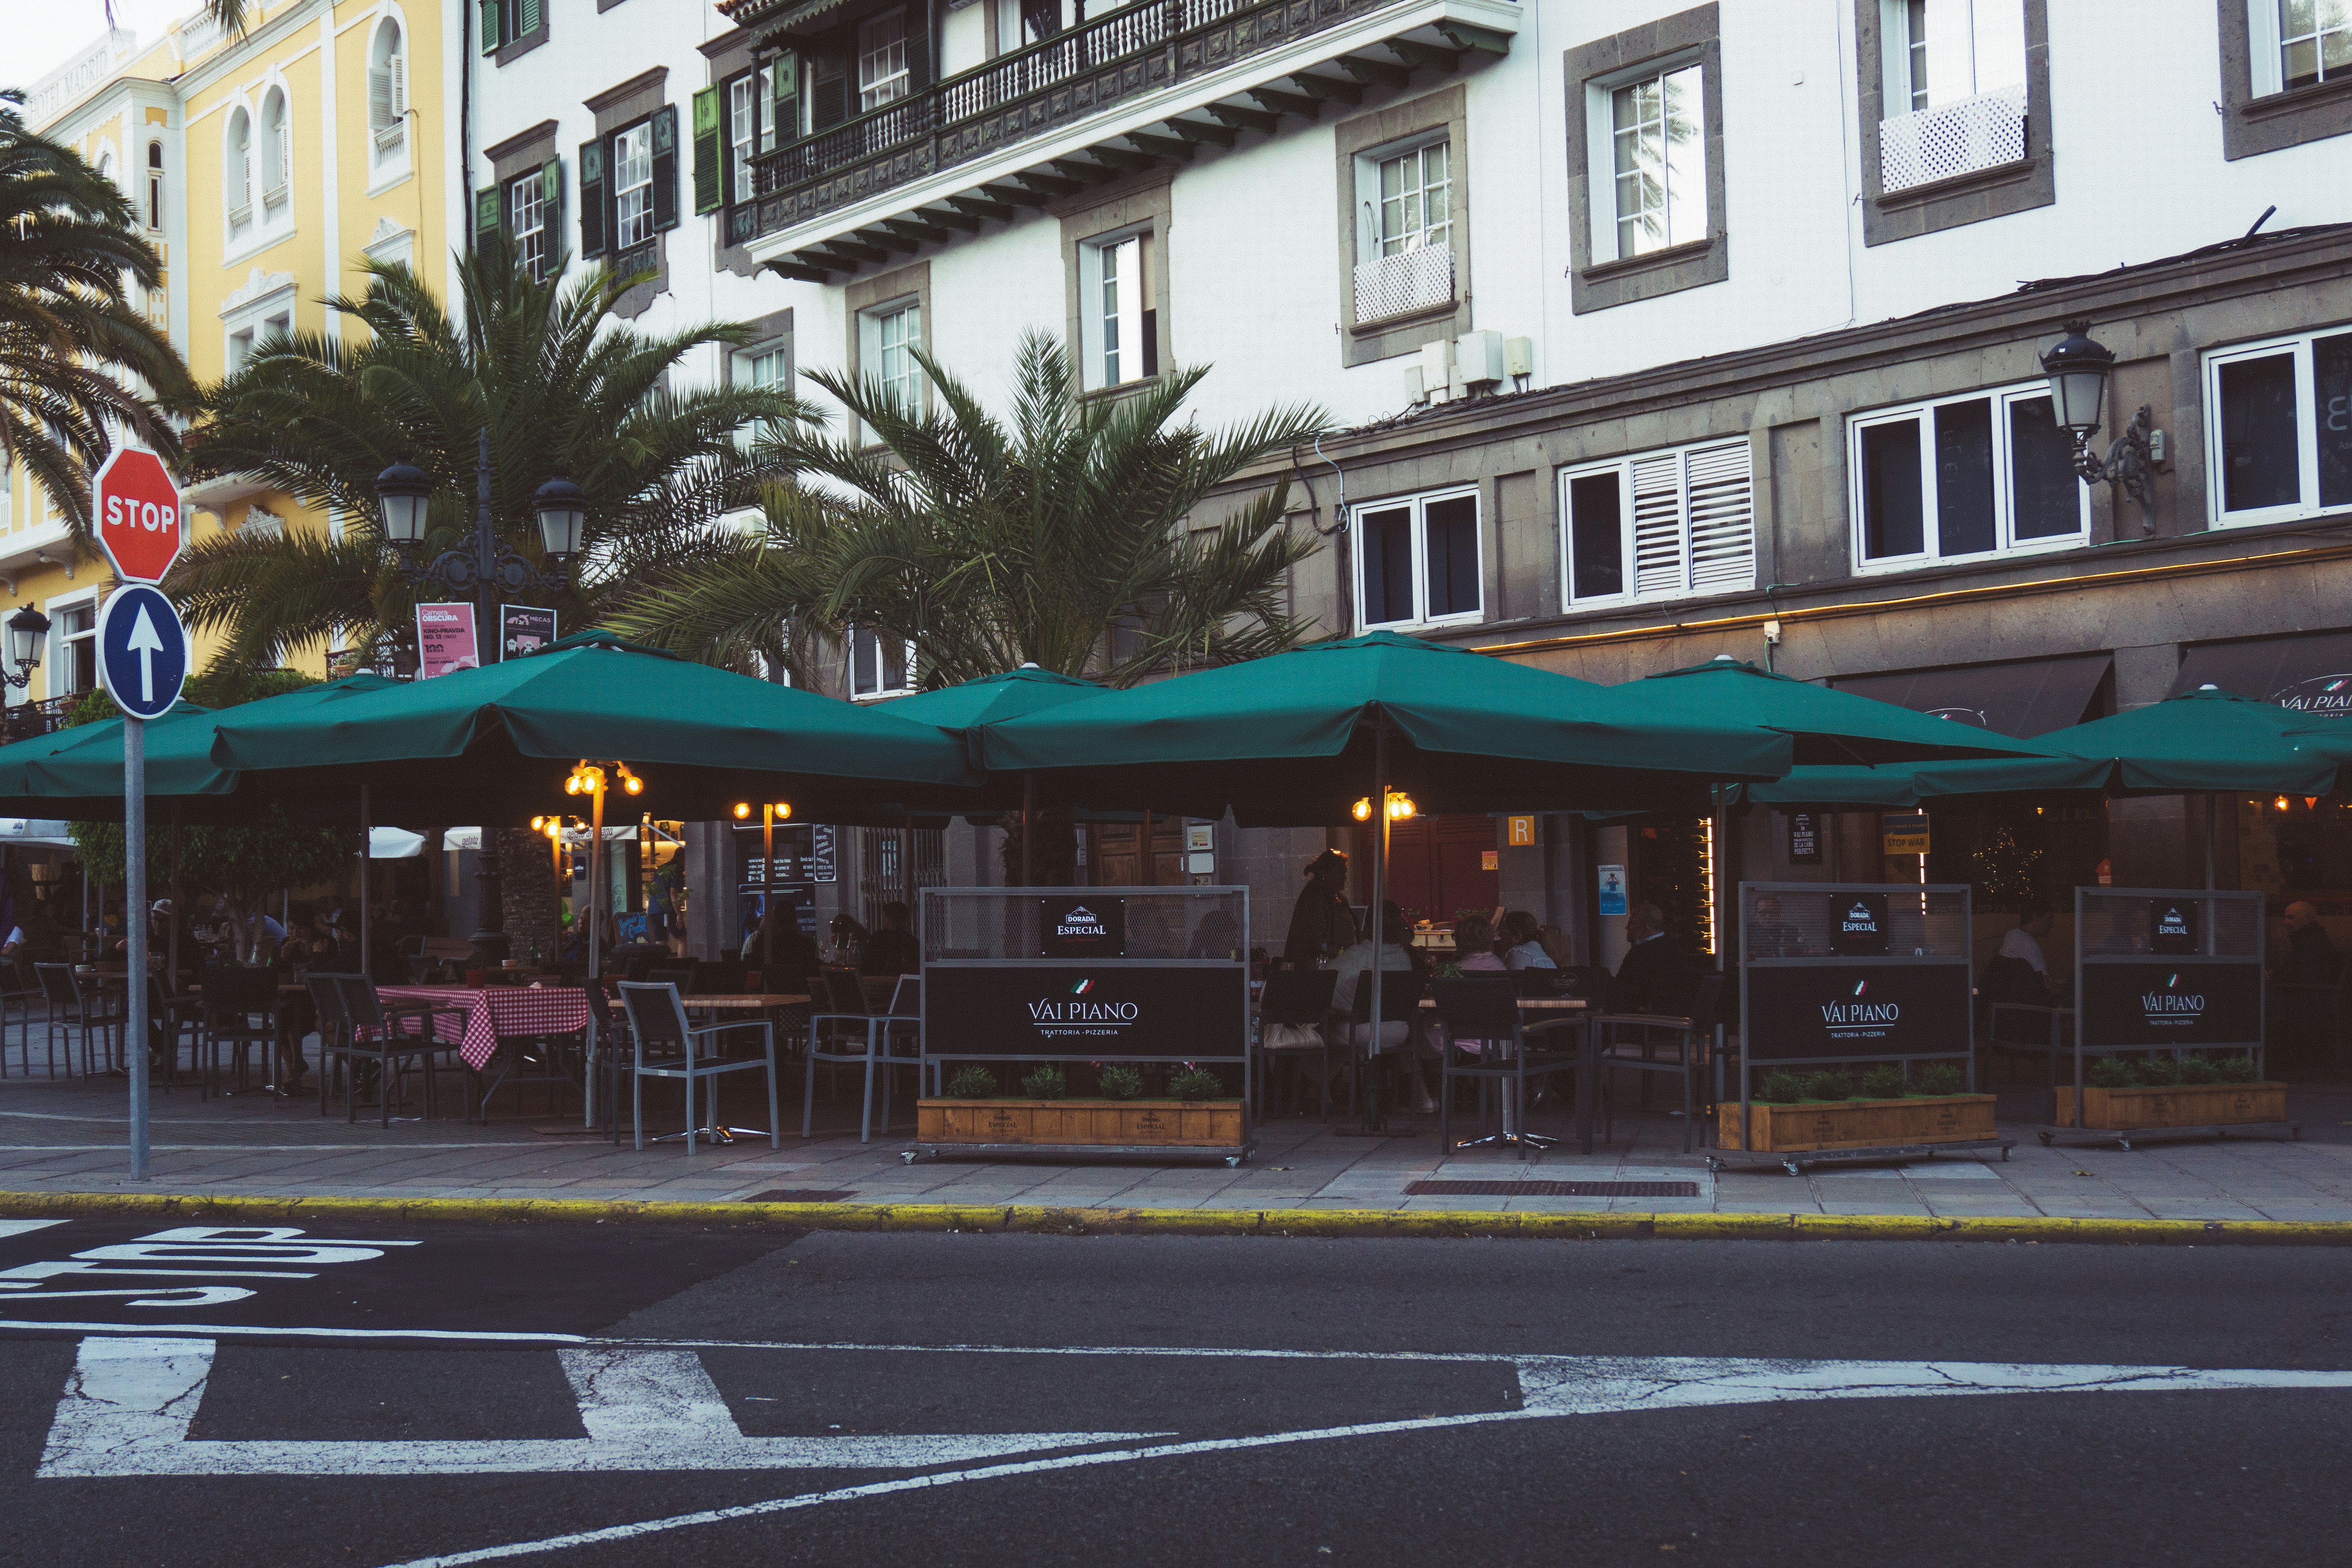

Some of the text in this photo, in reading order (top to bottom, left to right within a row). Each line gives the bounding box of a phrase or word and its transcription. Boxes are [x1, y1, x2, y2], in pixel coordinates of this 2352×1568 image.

[30, 50, 107, 123] HOTEL MADRID
[106, 494, 175, 533] STOP
[2281, 695, 2311, 710] VAI
[1514, 819, 1528, 842] R
[462, 836, 478, 847] gelato
[1888, 838, 1925, 847] STOP WAR
[1057, 924, 1106, 935] ESPECIAL
[1842, 921, 1877, 932] ESPECIAL
[2159, 925, 2188, 935] ESPECIAL
[1027, 997, 1138, 1019] VAI PIANO
[2142, 991, 2205, 1011] VAI PIANO
[1821, 1000, 1899, 1022] VAI PIANO
